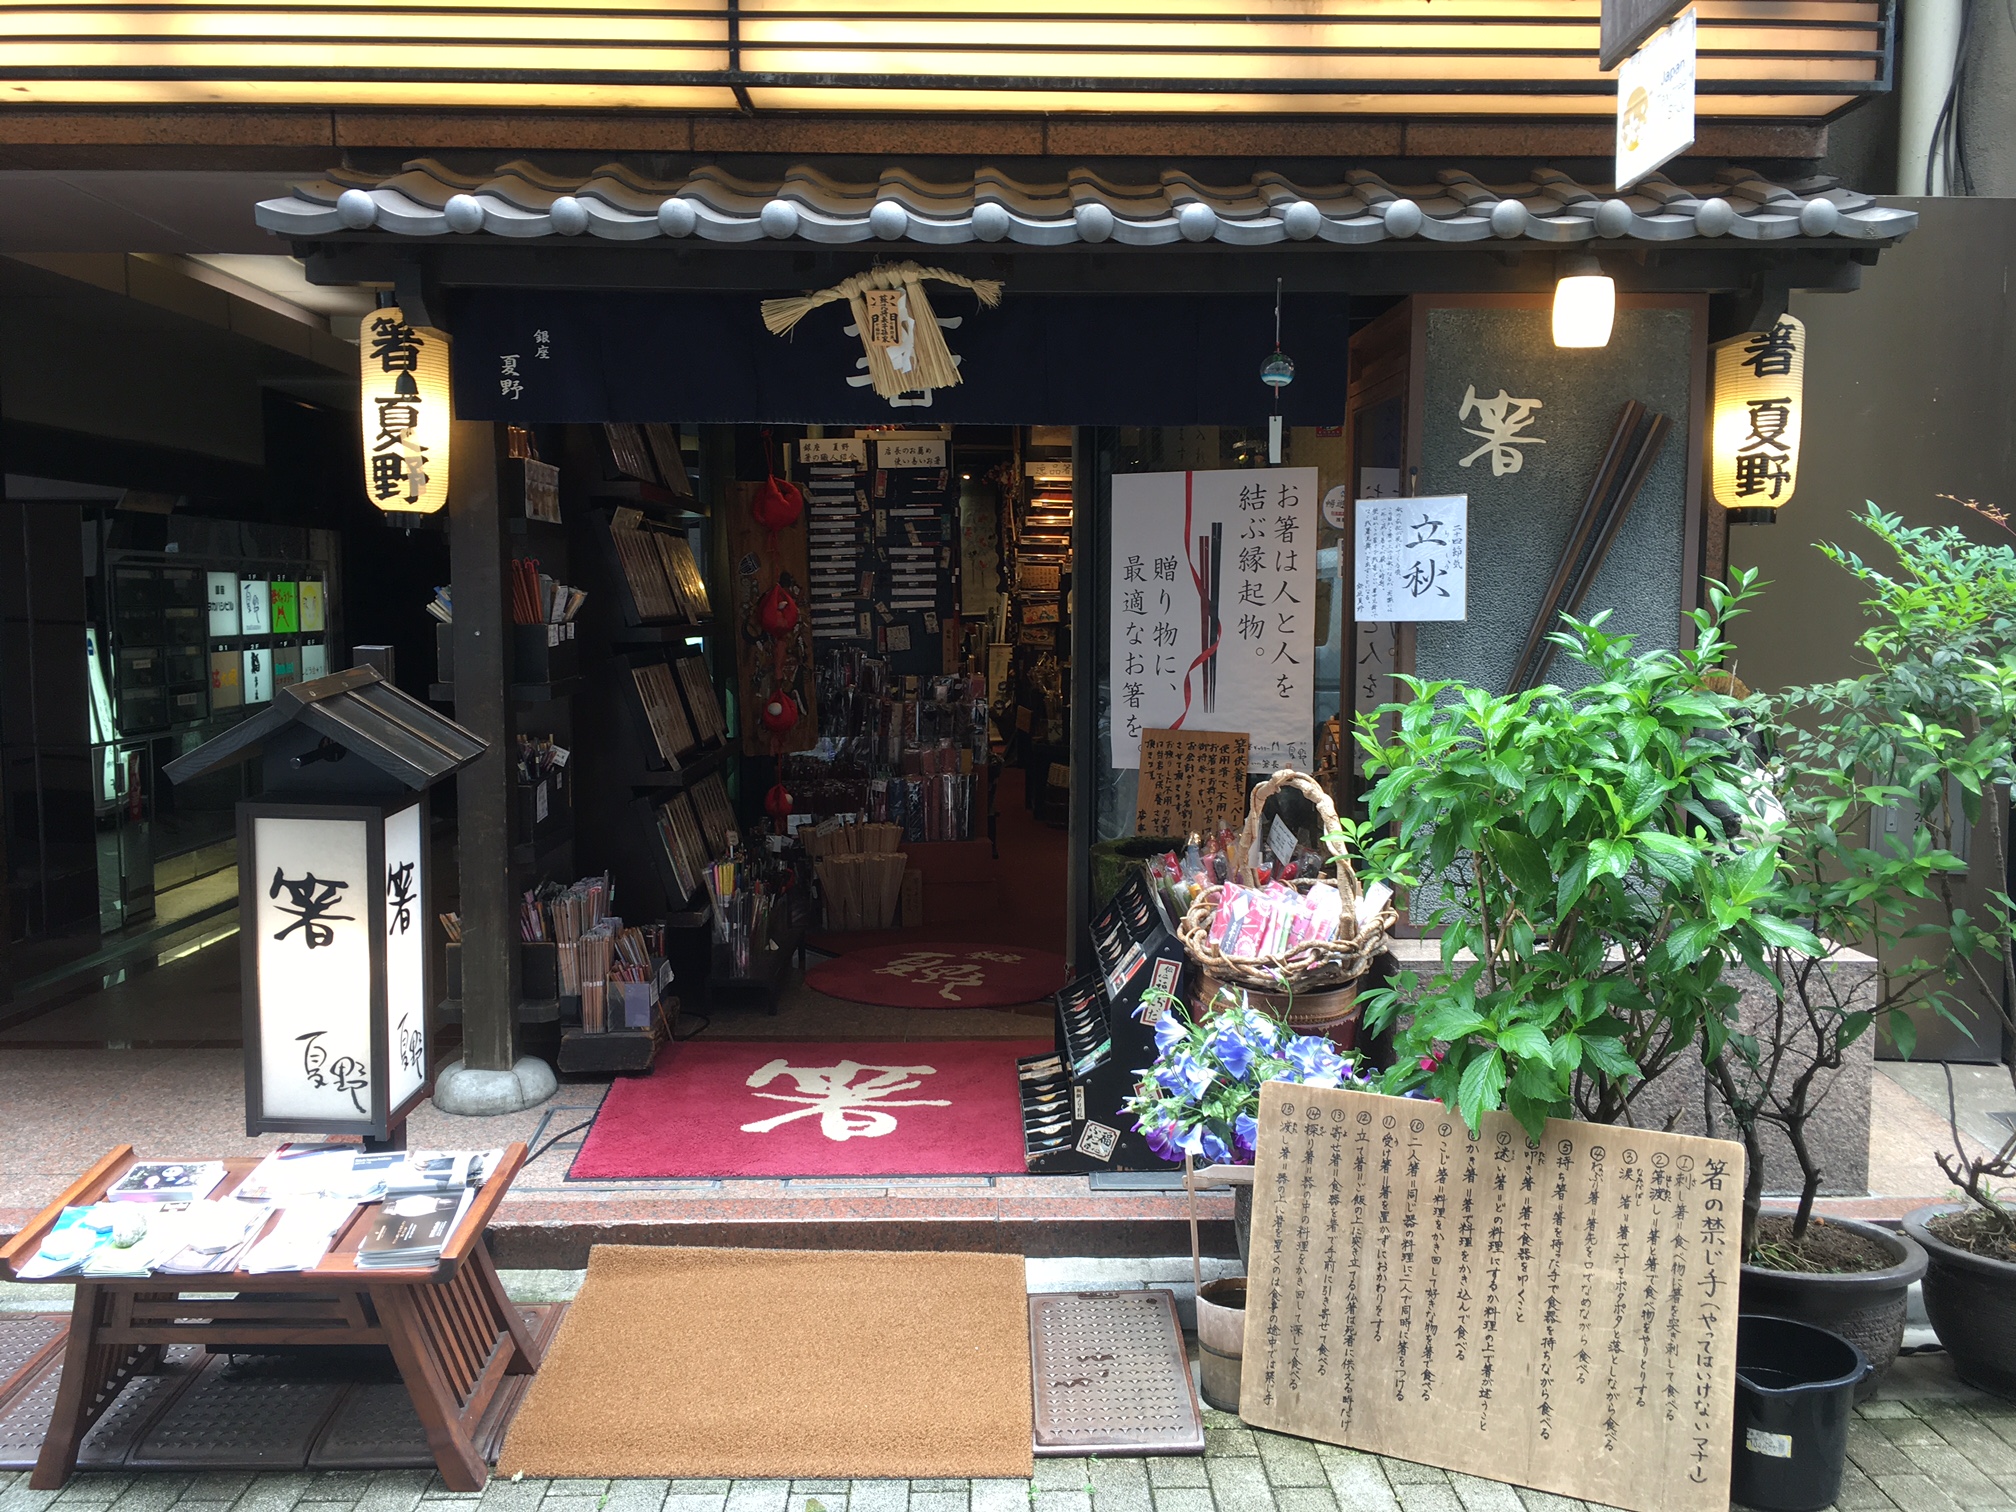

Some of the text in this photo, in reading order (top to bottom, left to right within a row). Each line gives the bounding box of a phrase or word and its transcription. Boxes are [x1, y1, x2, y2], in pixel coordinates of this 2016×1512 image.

[369, 317, 424, 373] 箸
[500, 354, 524, 400] 夏野
[533, 328, 550, 359] 銀座
[1458, 383, 1547, 477] 箸
[1735, 321, 1796, 500] 箸 夏野
[1237, 485, 1268, 657] 結ぶ縁起物。
[1271, 485, 1300, 699] お箸は人と人を
[1402, 513, 1450, 598] 立秋
[1153, 556, 1178, 691] 贈り物に、
[270, 866, 356, 949] 箸
[387, 860, 417, 935] 箸
[295, 1030, 368, 1114] 夏野
[397, 1012, 423, 1079] 夏野
[740, 1058, 952, 1141] 箸
